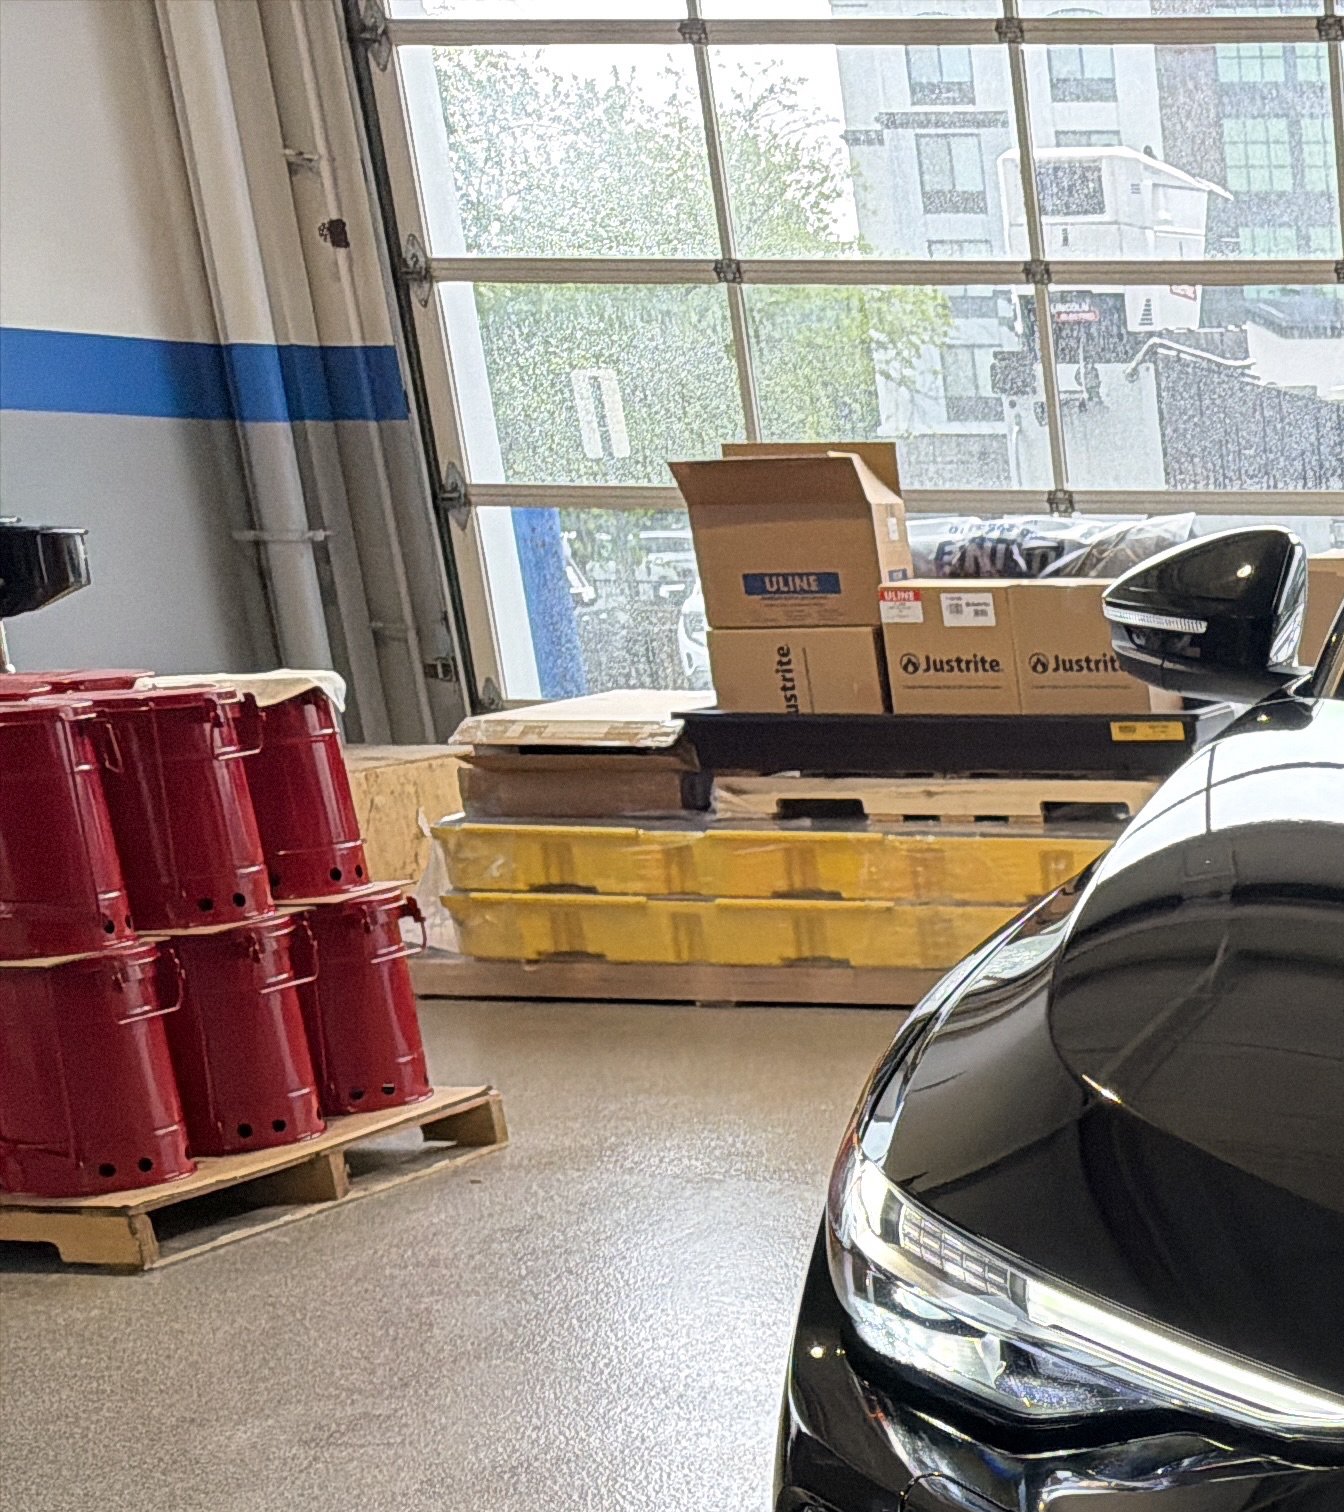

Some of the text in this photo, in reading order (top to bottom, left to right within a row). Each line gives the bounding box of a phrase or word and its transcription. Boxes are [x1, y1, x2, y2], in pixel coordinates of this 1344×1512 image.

[764, 575, 820, 592] ULINE
[883, 590, 915, 601] ULINE
[923, 653, 1001, 674] Justrite
[1051, 652, 1127, 673] Justrit
[775, 645, 800, 715] ustrite
